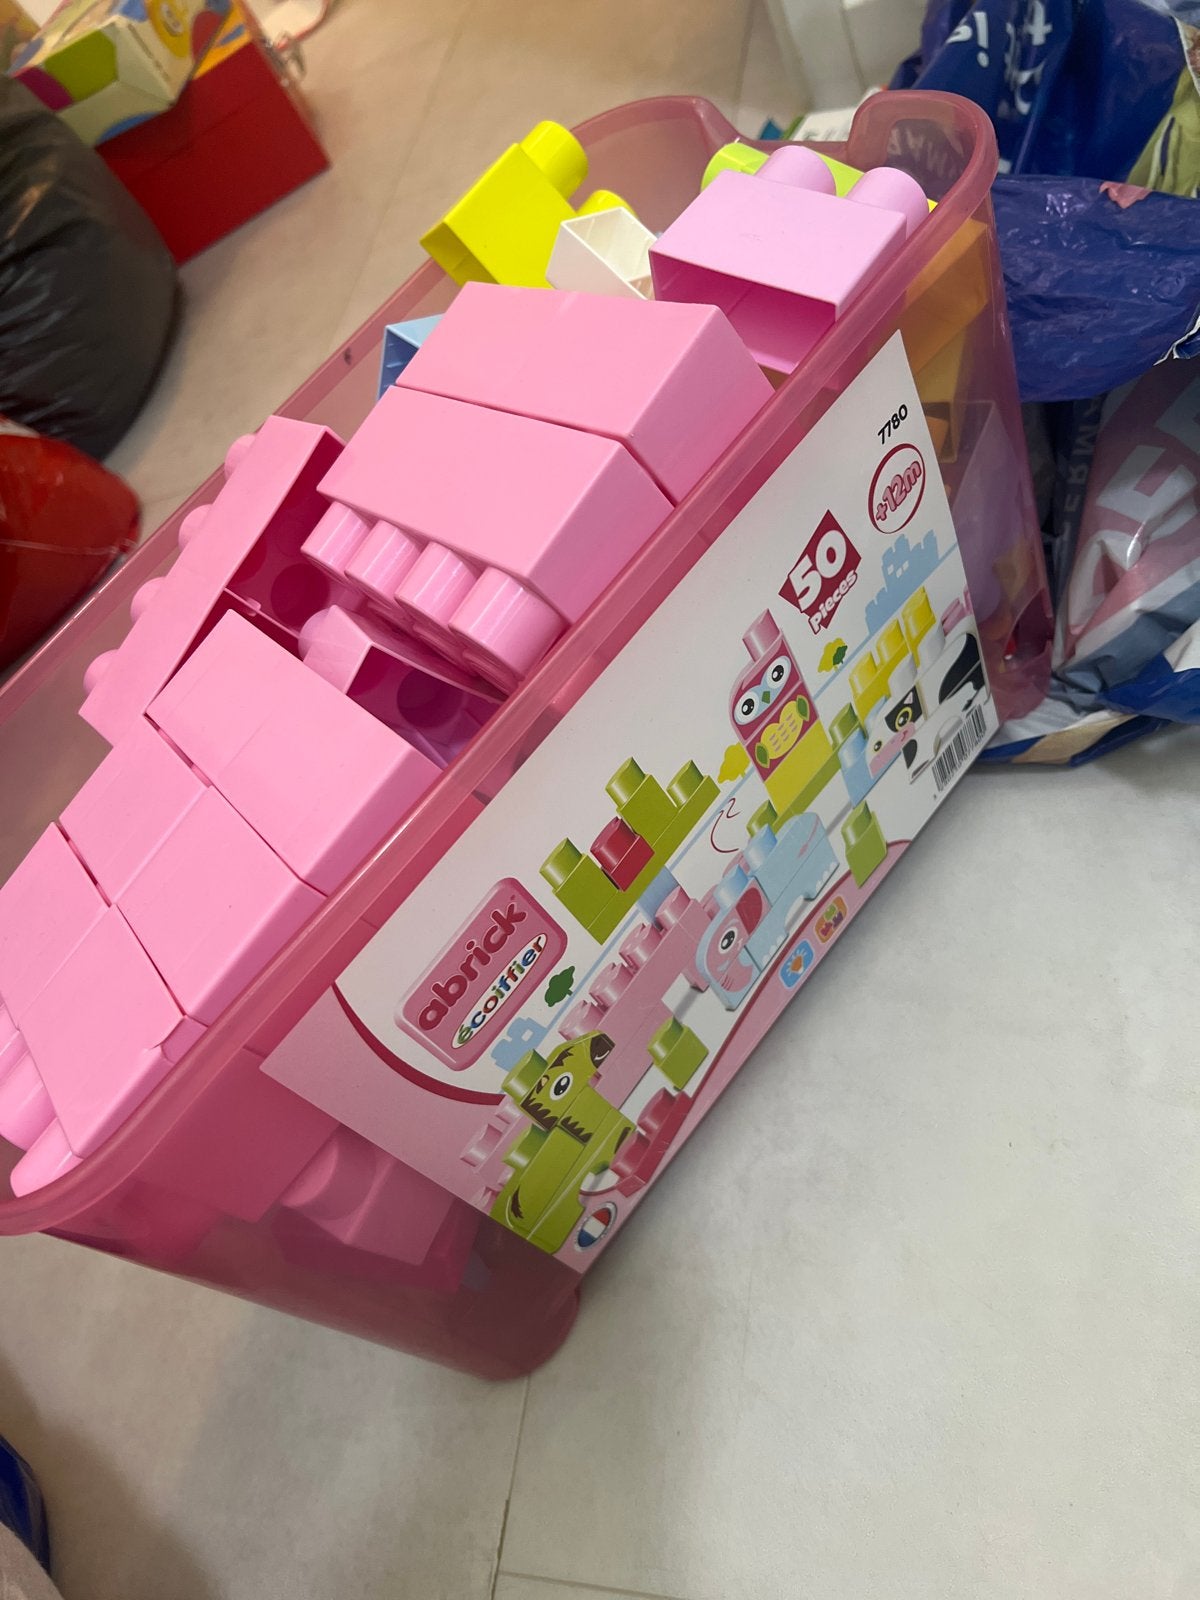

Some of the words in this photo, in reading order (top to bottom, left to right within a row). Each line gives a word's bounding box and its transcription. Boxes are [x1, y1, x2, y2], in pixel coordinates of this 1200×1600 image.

[878, 404, 908, 444] 7780
[788, 529, 847, 612] 50
[418, 903, 527, 1031] abrick
